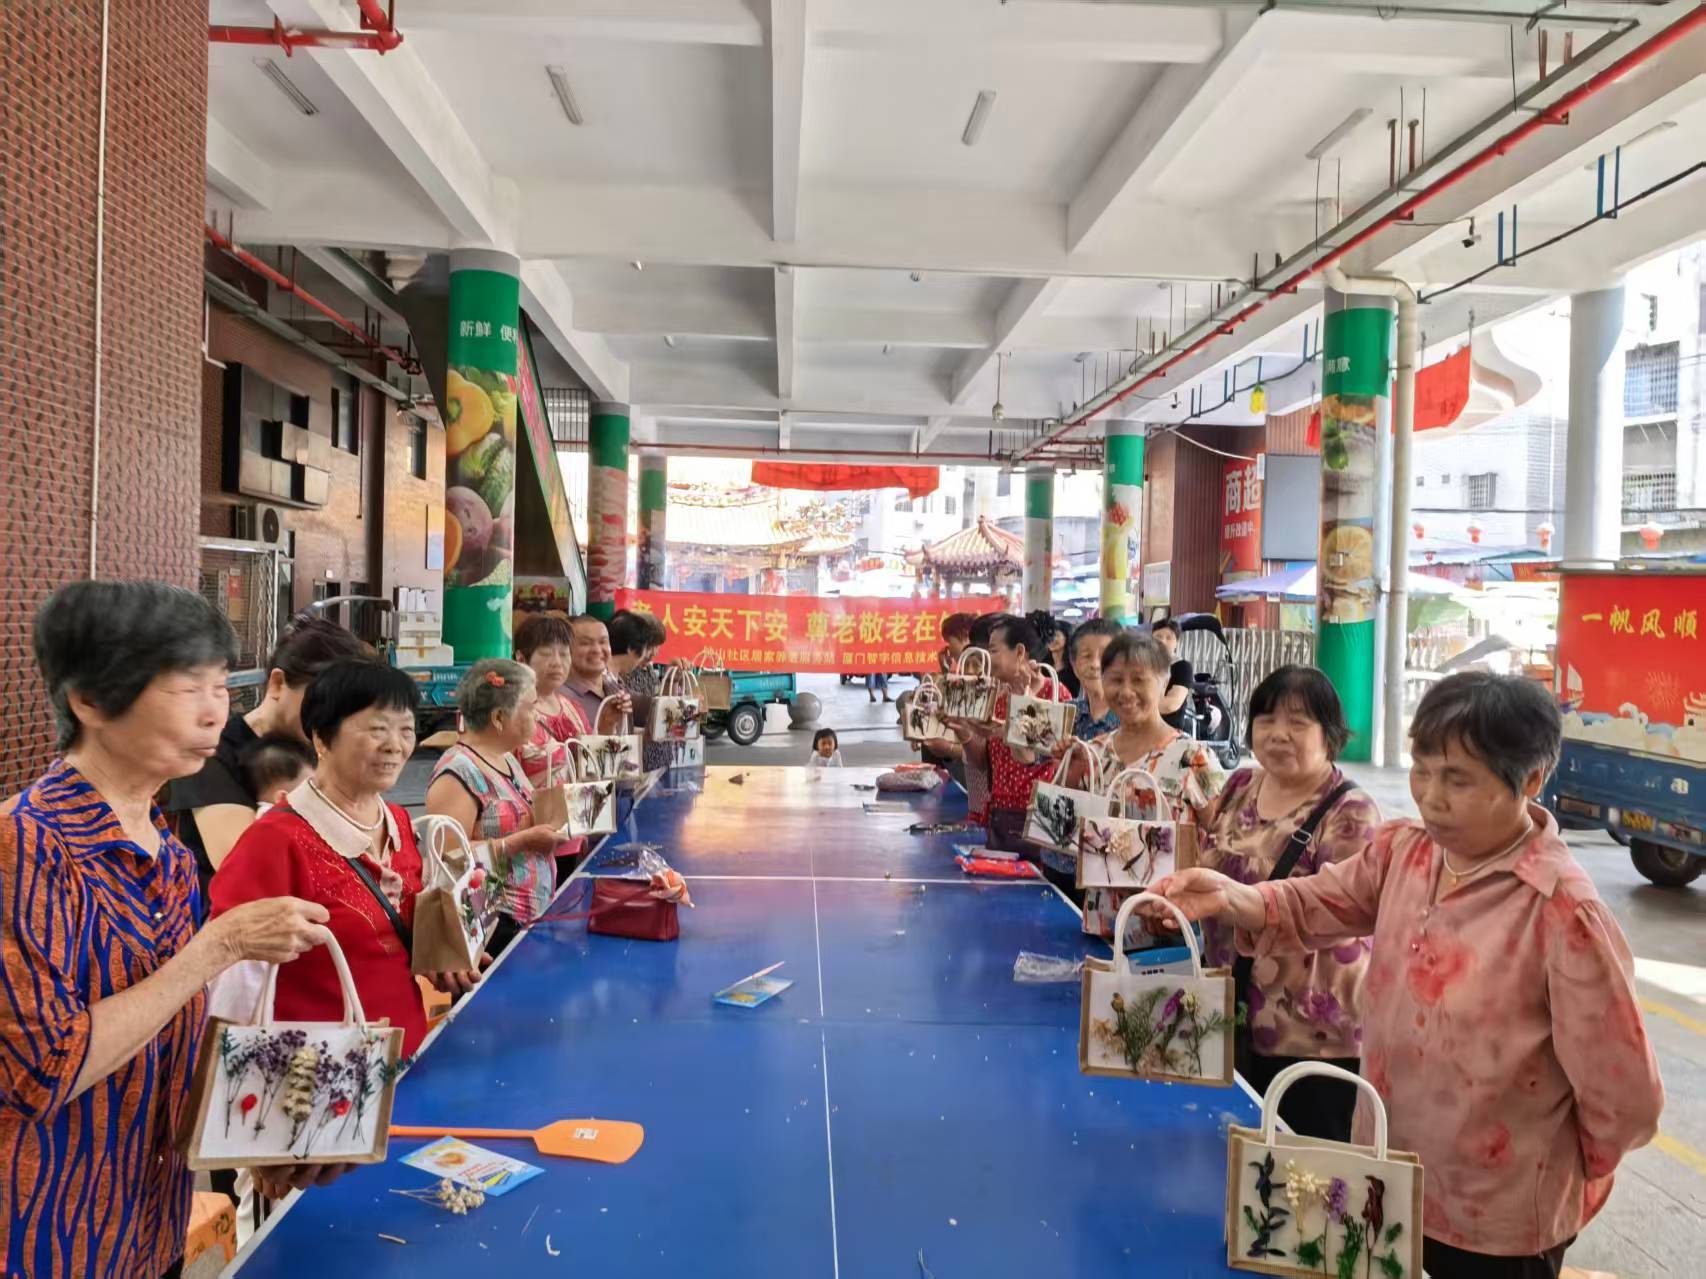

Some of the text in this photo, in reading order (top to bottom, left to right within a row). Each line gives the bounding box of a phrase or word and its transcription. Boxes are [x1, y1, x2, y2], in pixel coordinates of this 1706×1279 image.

[460, 320, 491, 337] 新鲜
[1225, 464, 1261, 517] 商超
[805, 609, 950, 644] 尊老敬老在
[1582, 604, 1697, 639] 一帆风顺
